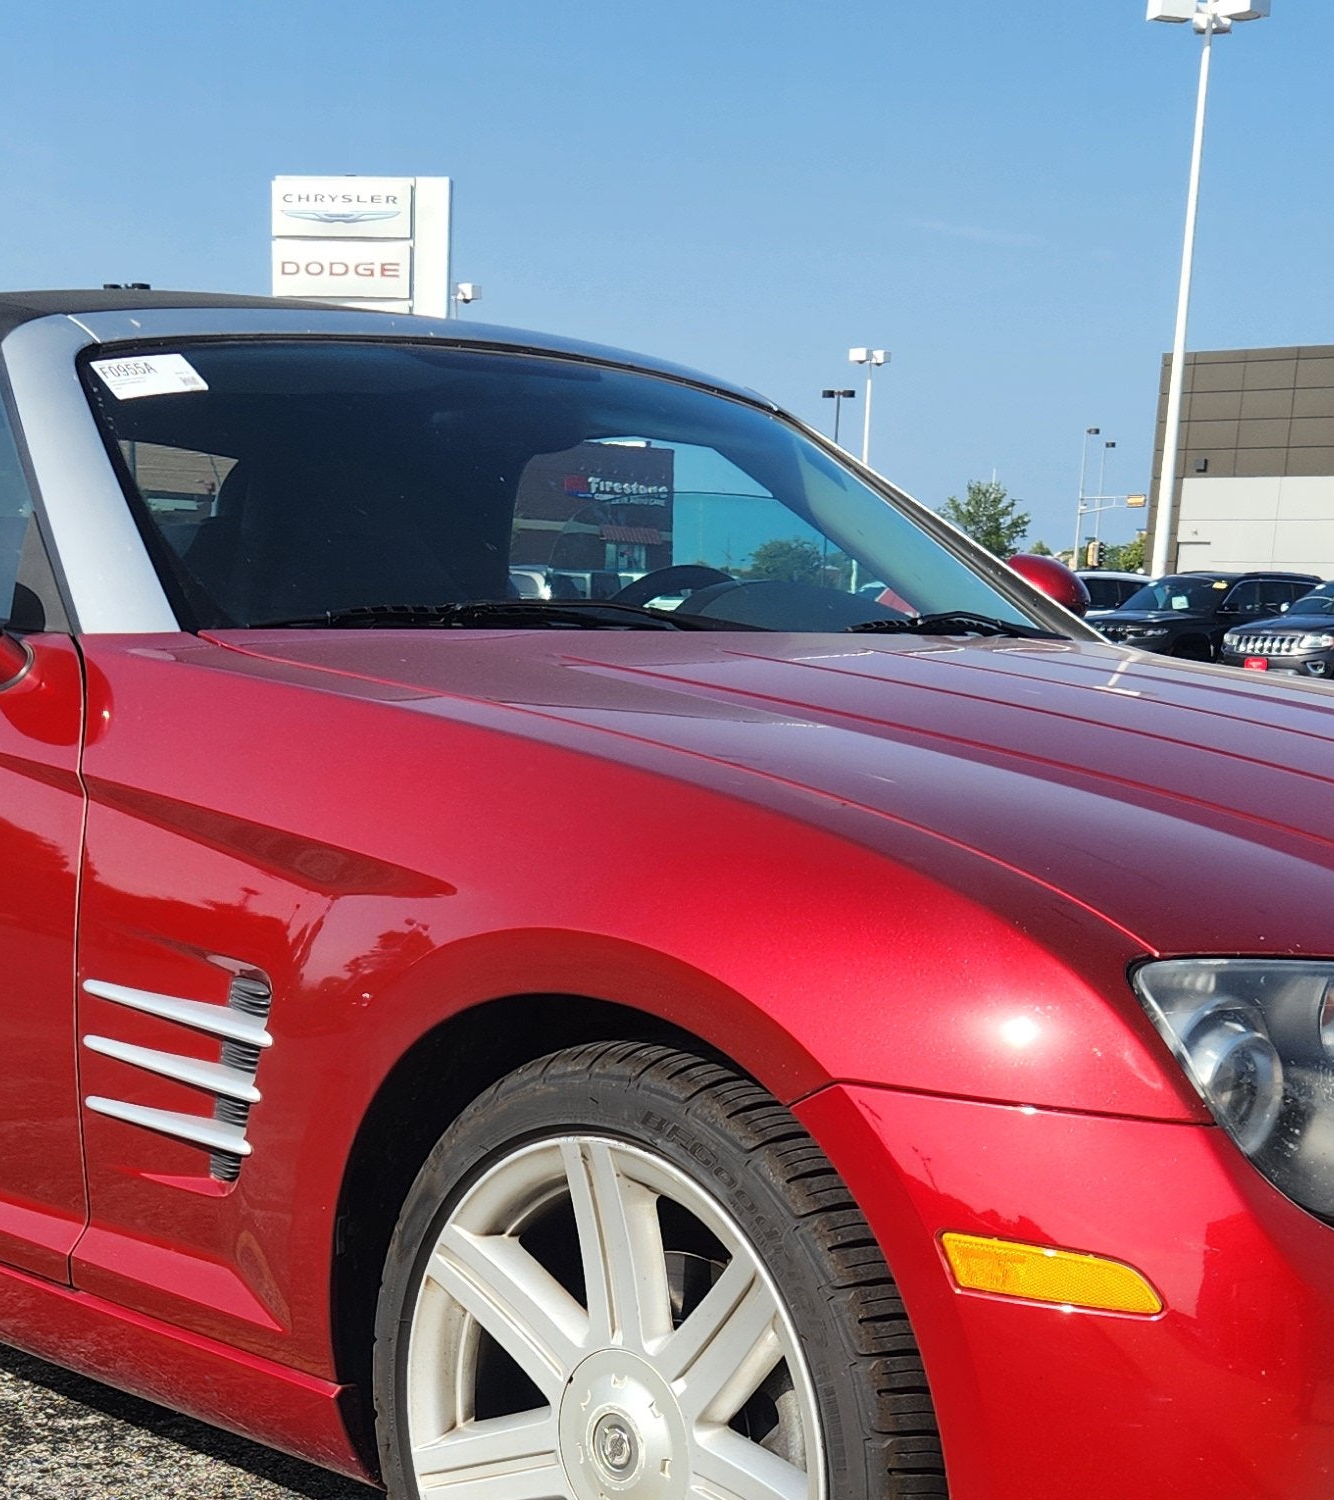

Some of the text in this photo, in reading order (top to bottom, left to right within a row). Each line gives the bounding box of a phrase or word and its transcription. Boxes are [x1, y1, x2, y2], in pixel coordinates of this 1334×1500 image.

[283, 194, 398, 204] CHRYSLER
[281, 260, 401, 278] DODGE
[99, 362, 159, 378] F0955A
[587, 476, 669, 494] Firestone
